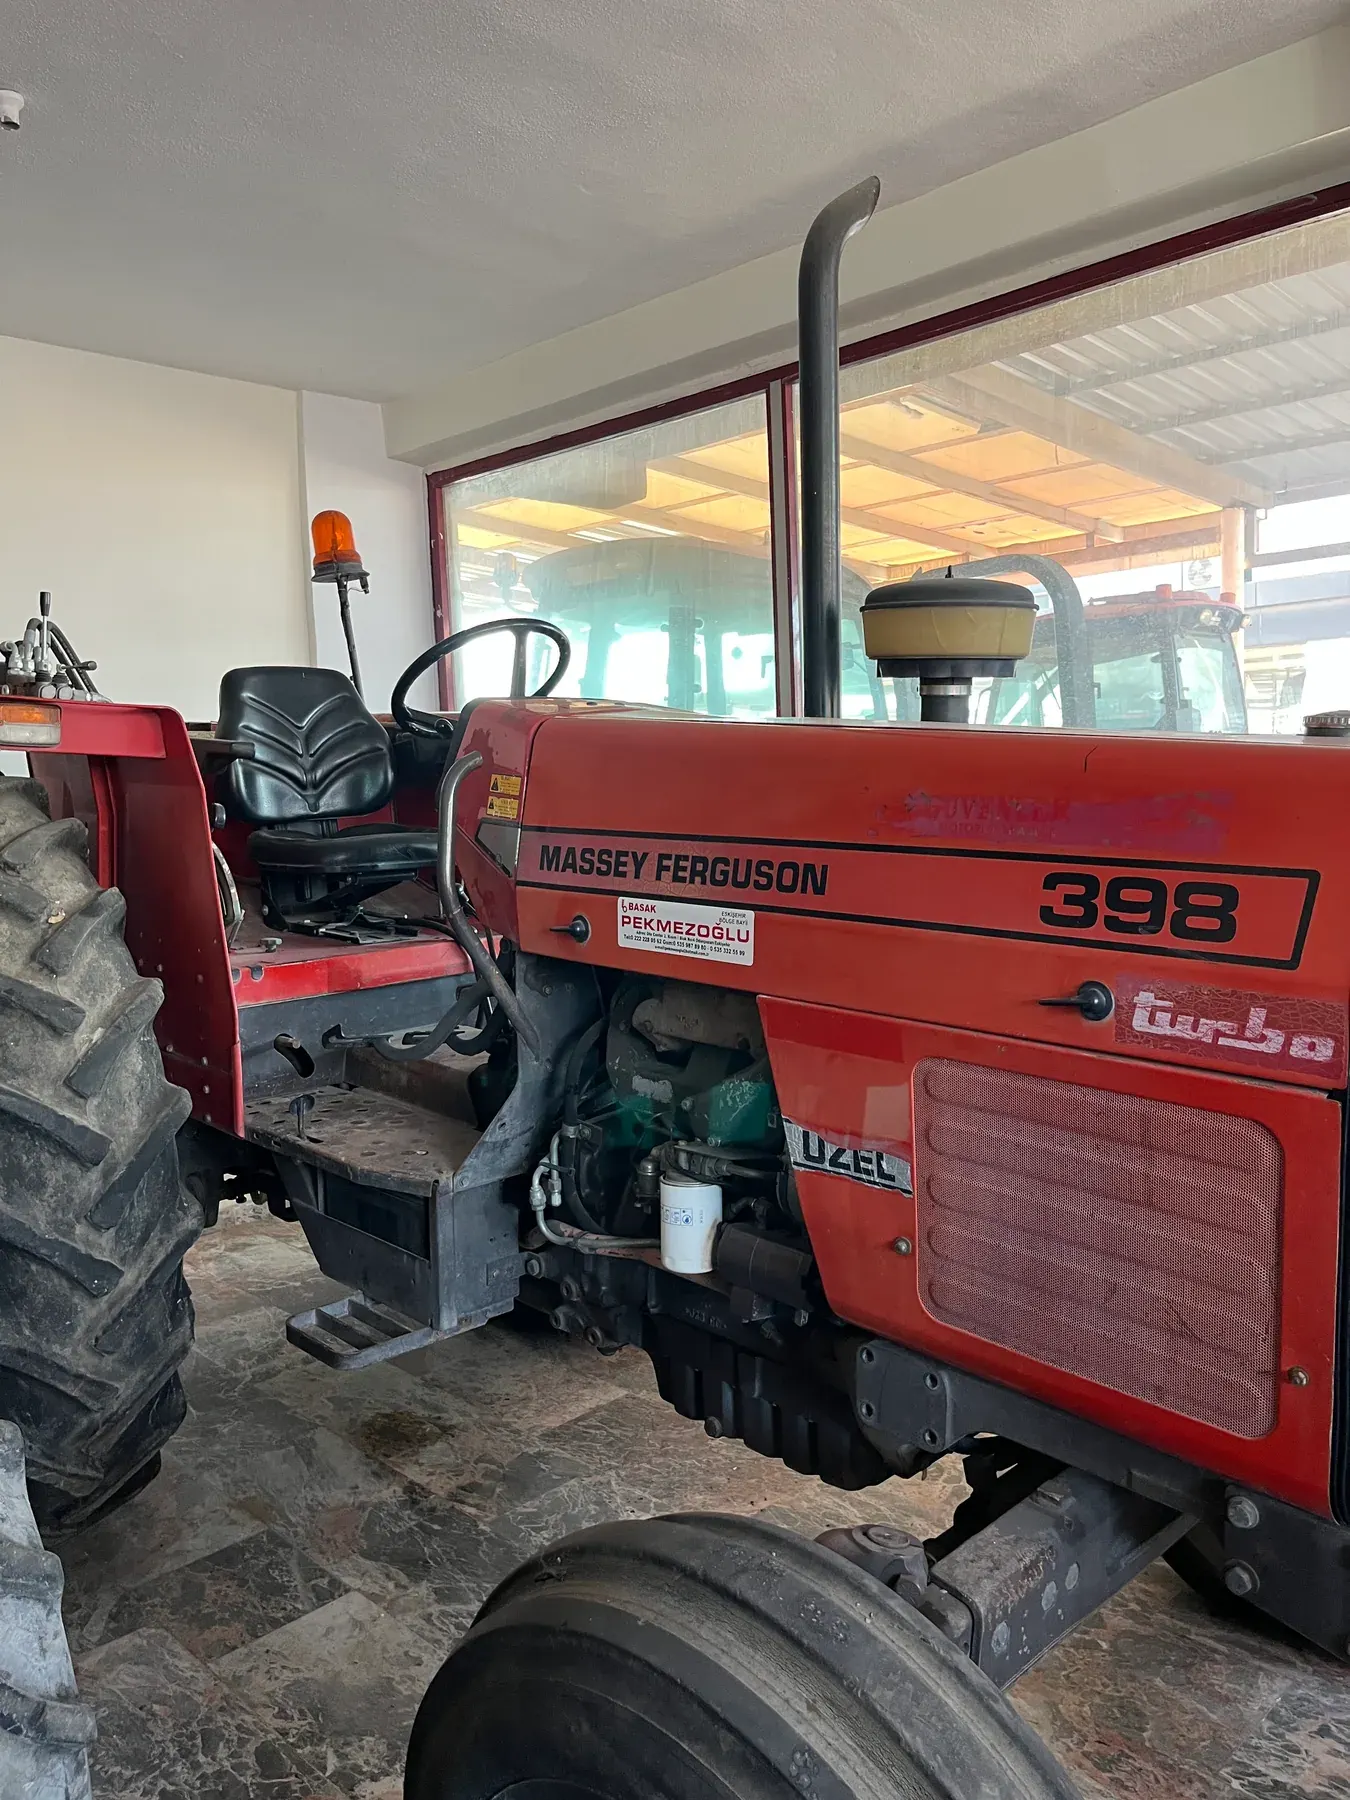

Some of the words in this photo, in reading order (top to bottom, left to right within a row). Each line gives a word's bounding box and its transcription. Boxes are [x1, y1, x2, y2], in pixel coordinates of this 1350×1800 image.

[540, 845, 649, 880] MASSEY
[655, 853, 829, 896] FERGUSON
[621, 915, 750, 943] PEKMEZOĞLU
[629, 902, 656, 913] BASAK
[1039, 872, 1240, 943] 398
[1132, 991, 1335, 1062] turbo
